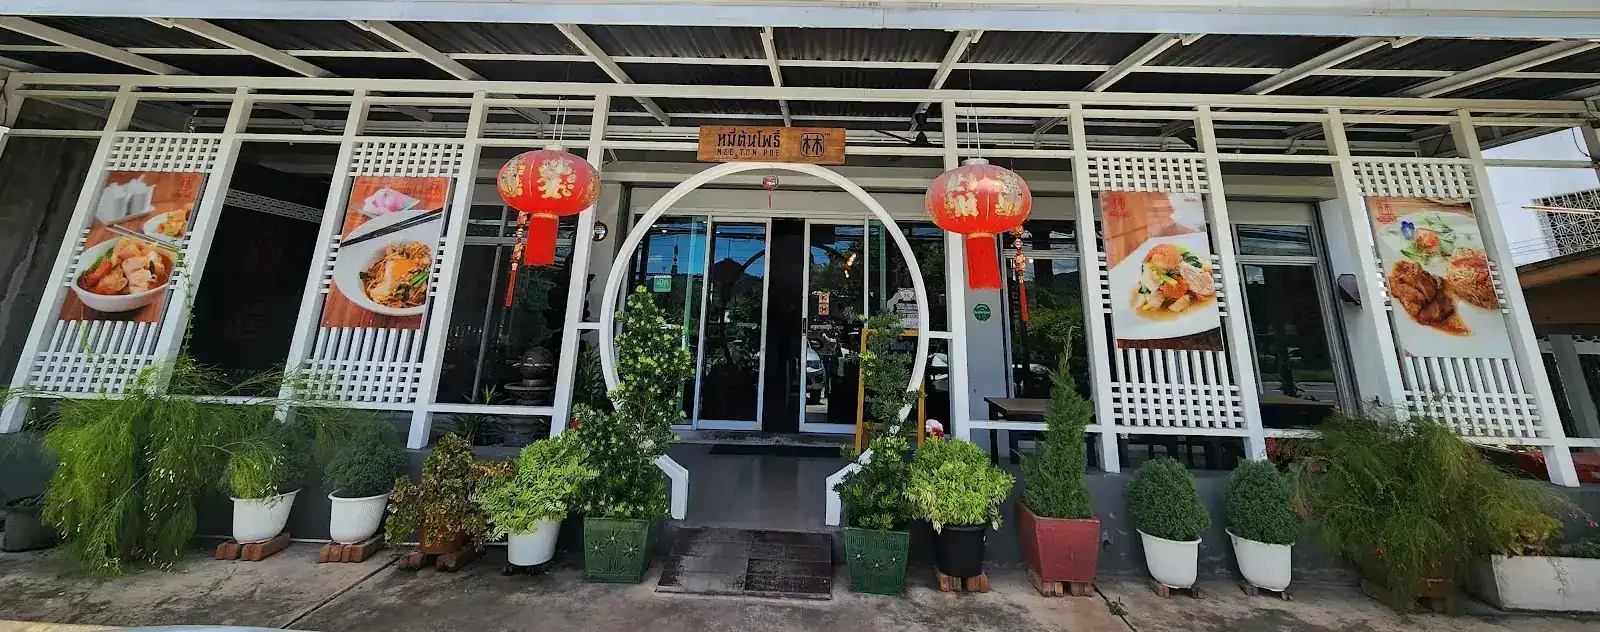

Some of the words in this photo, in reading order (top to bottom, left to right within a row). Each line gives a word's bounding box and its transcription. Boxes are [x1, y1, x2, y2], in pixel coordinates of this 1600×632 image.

[716, 148, 734, 156] MEE
[739, 148, 757, 156] TON
[763, 149, 780, 157] POE
